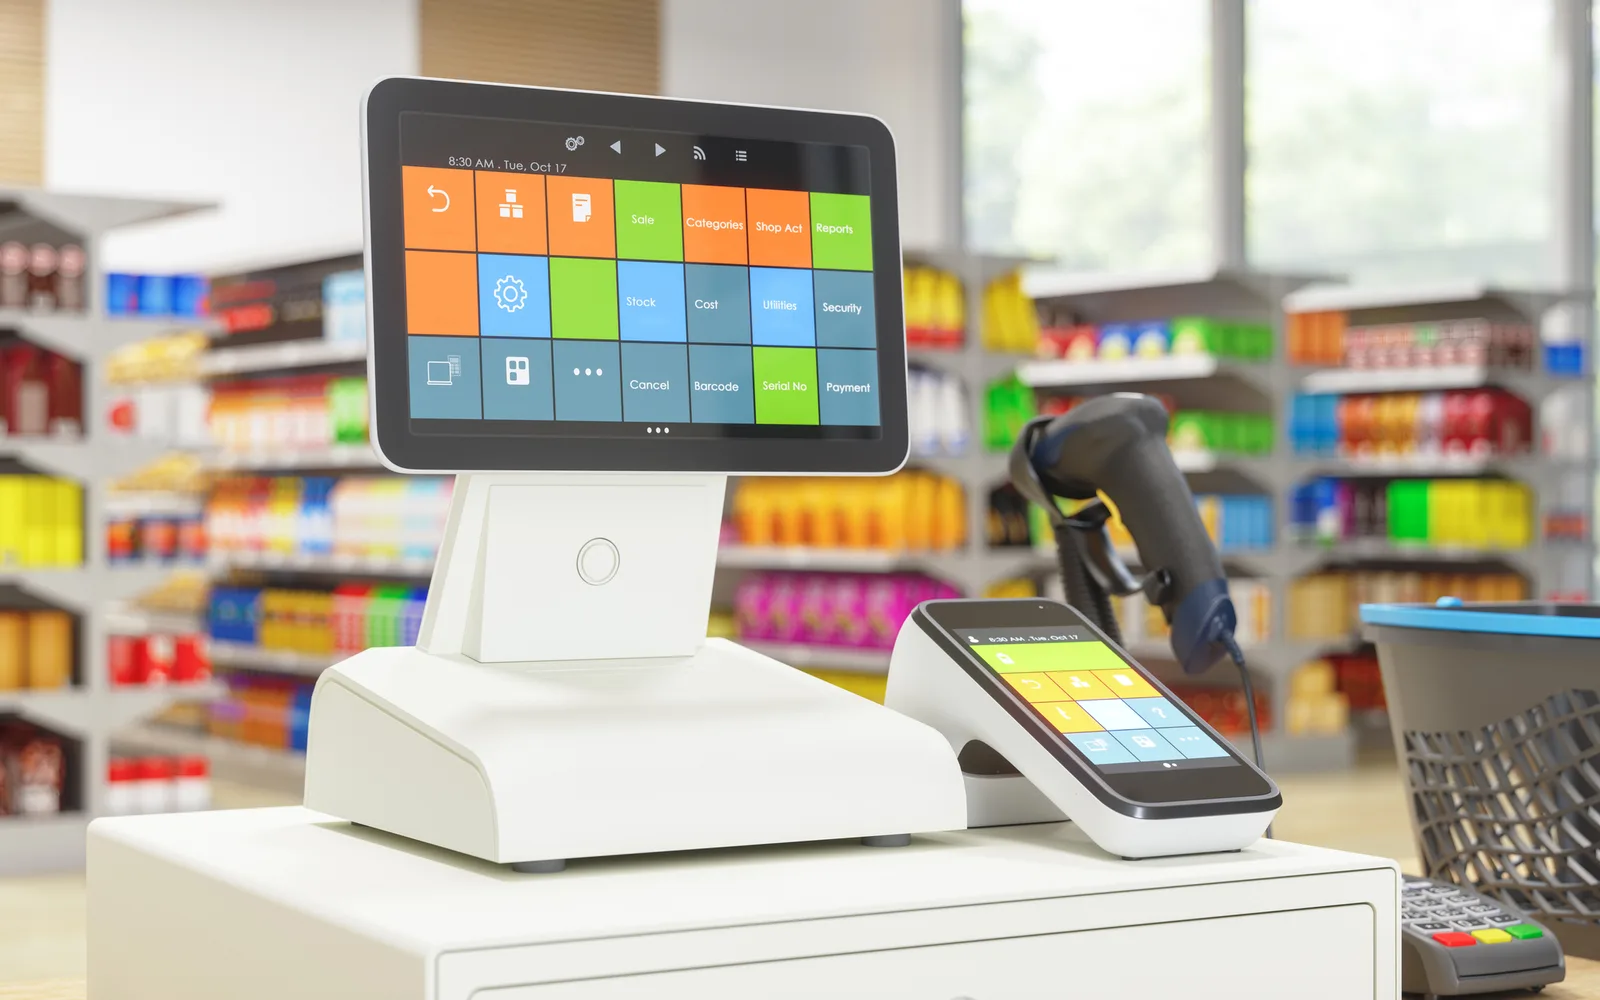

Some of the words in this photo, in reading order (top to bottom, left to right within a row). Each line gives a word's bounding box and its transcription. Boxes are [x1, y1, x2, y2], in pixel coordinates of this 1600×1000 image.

[448, 156, 472, 168] 8:30
[475, 158, 494, 169] AM
[504, 159, 527, 172] Tue,
[530, 161, 552, 173] Oct
[555, 163, 567, 174] 17
[631, 214, 655, 226] Sale
[686, 217, 744, 231] Categories
[755, 221, 782, 235] Shop
[784, 223, 803, 234] Act
[816, 222, 854, 235] Reports
[626, 296, 657, 308] Stock
[694, 299, 719, 310] Cost
[762, 300, 798, 311] Utilities
[822, 302, 863, 315] Security
[629, 379, 670, 391] Cancel
[694, 381, 740, 393] Barcode
[762, 380, 791, 392] Serial
[792, 381, 808, 392] No
[826, 382, 871, 394] Payment
